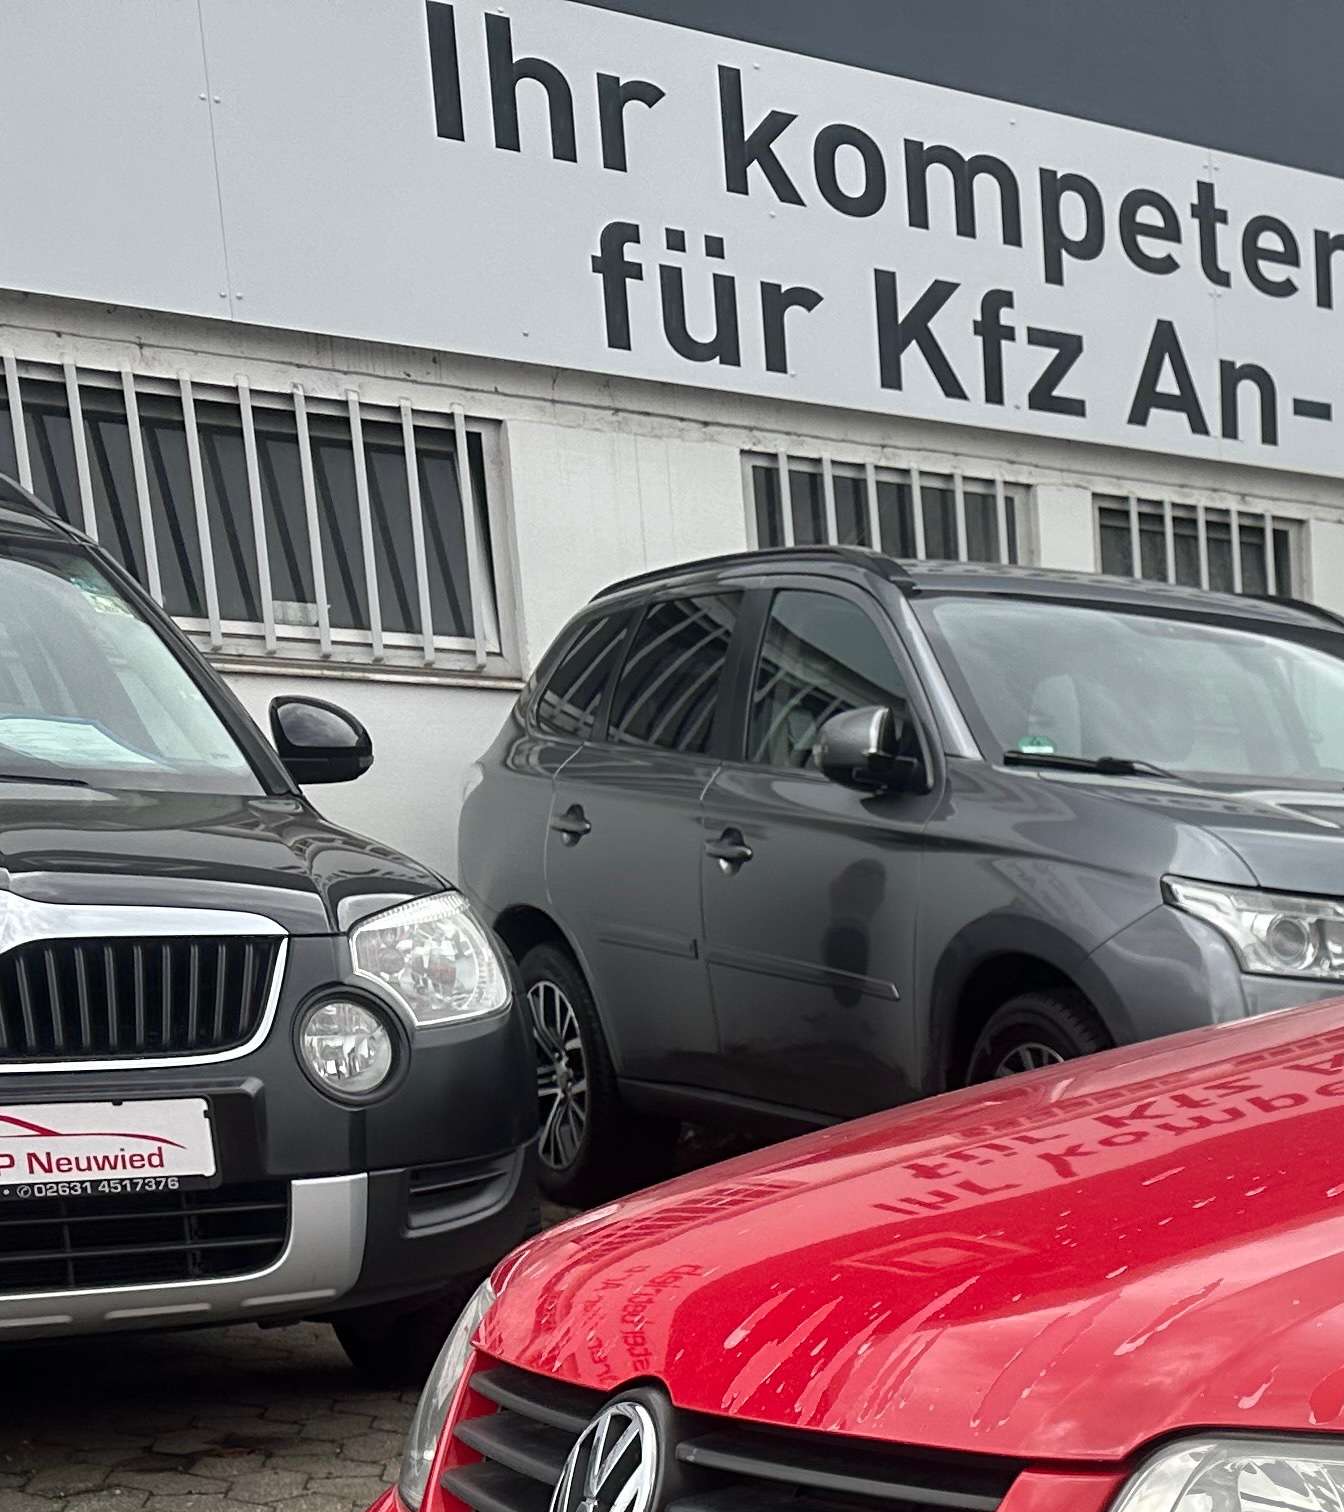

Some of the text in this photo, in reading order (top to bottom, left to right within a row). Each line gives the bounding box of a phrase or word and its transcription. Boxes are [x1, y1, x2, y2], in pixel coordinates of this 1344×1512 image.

[425, 0, 667, 173] Ihr
[591, 221, 824, 375] für
[873, 268, 1087, 419] Kfz
[1126, 319, 1334, 447] An-
[26, 1146, 165, 1174] Neuwied
[34, 1177, 179, 1197] 02631 4517376
